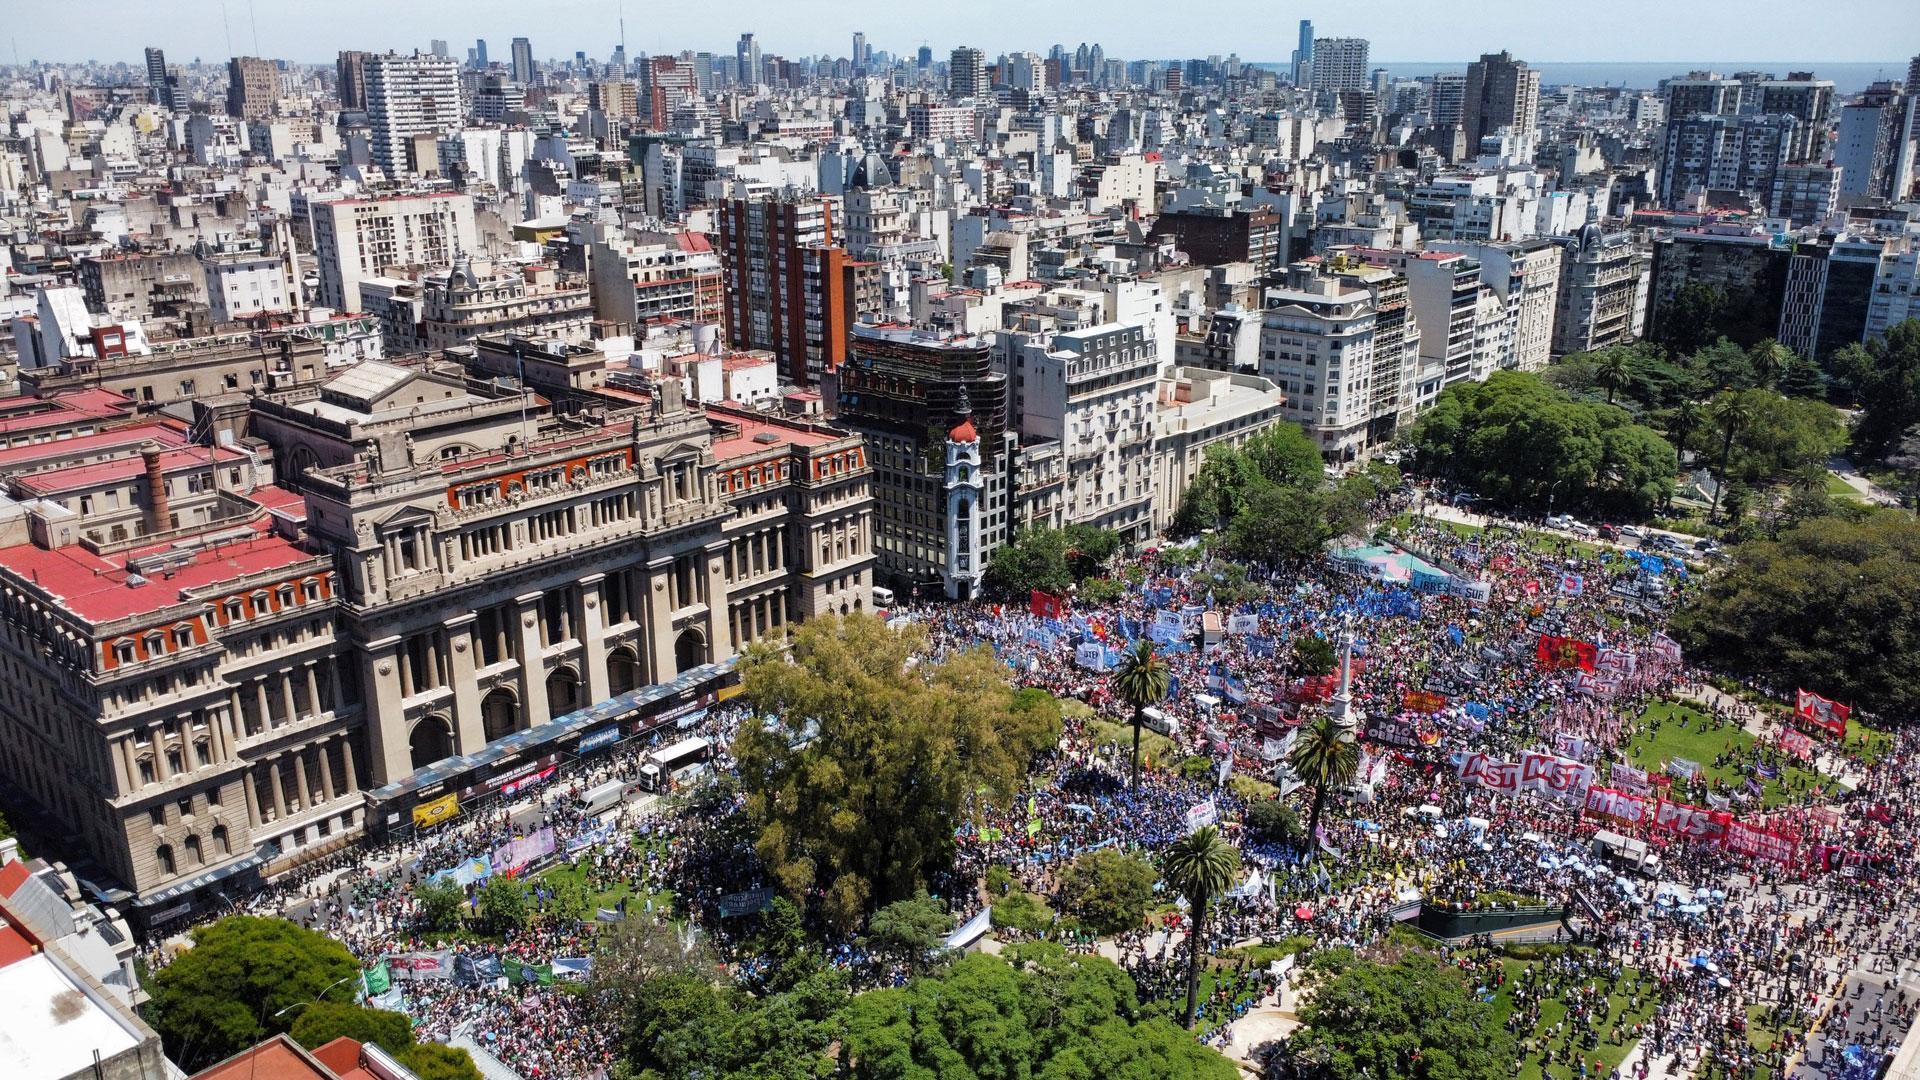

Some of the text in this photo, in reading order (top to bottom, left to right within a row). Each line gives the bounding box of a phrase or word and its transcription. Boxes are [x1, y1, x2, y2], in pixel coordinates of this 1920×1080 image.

[1413, 577, 1449, 593] LIBRES
[1465, 587, 1484, 600] SUR
[1602, 651, 1629, 669] MST
[1799, 694, 1832, 723] PTS
[1368, 728, 1418, 747] OBRERO
[1379, 722, 1411, 736] POLO
[1468, 758, 1519, 788] MST
[1525, 754, 1585, 793] MST
[1657, 802, 1710, 835] PTS
